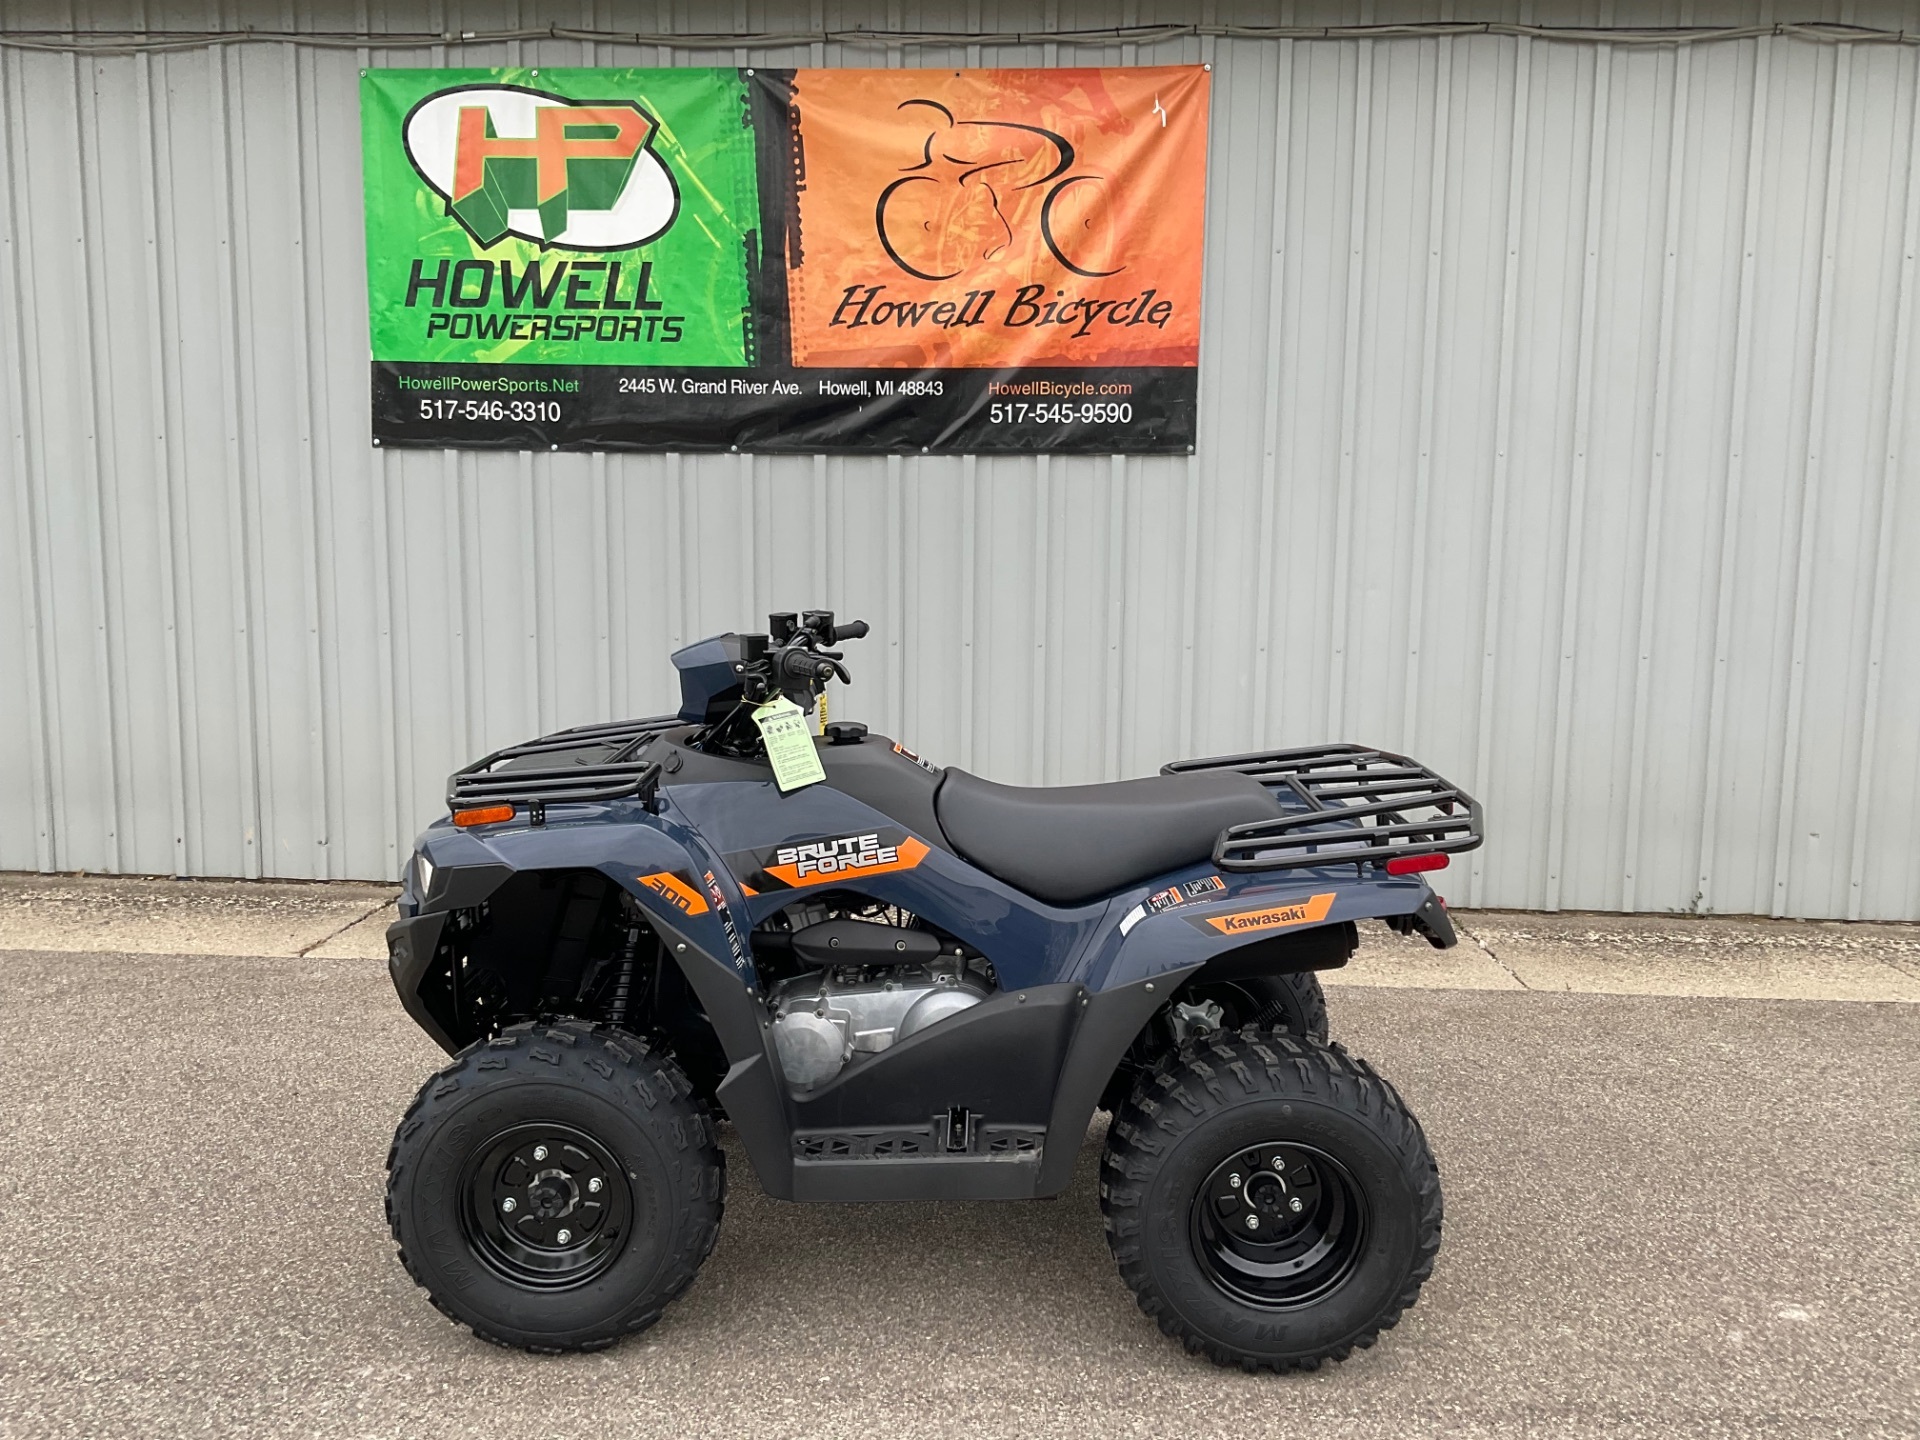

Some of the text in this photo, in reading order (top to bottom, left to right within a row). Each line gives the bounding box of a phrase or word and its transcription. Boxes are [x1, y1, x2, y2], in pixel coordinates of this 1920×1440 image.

[452, 106, 653, 215] HP
[404, 258, 664, 311] HOWELL
[829, 284, 1174, 339] Howell Bicycle
[426, 313, 685, 343] POWERSPORTS
[398, 375, 580, 395] HowellPowerSports.Net
[619, 378, 944, 397] 2445 W. Grand River Ave. Howell, MI 48843
[988, 381, 1133, 399] HowellBicycle.com
[419, 400, 561, 423] 517-546-3310
[989, 403, 1133, 424] 517-545-9590
[776, 833, 880, 865] BRUTE
[796, 846, 899, 879] FORCE
[649, 877, 692, 912] 300
[1224, 906, 1306, 931] Kawasaki
